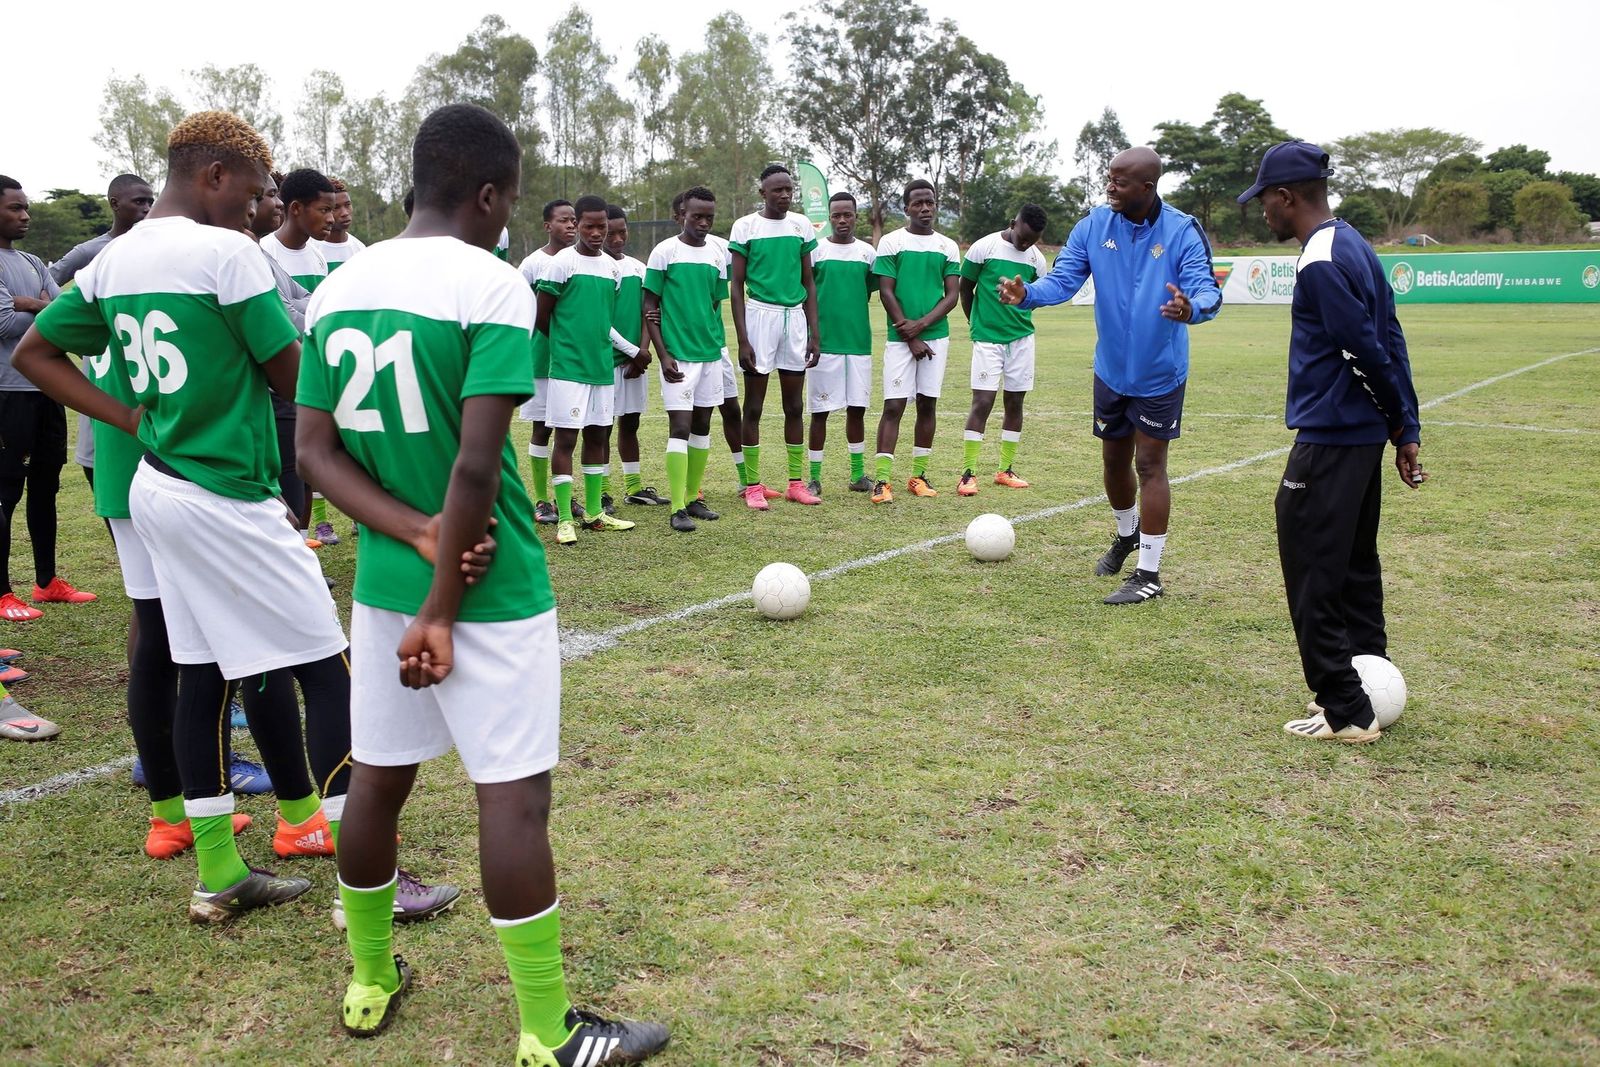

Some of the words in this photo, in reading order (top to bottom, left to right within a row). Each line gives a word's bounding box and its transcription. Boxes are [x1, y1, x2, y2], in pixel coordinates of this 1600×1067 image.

[1271, 262, 1295, 278] Betis
[1271, 280, 1293, 296] Acad
[1504, 277, 1562, 286] ZIMBABWE
[114, 309, 188, 394] 36
[325, 327, 430, 434] 21
